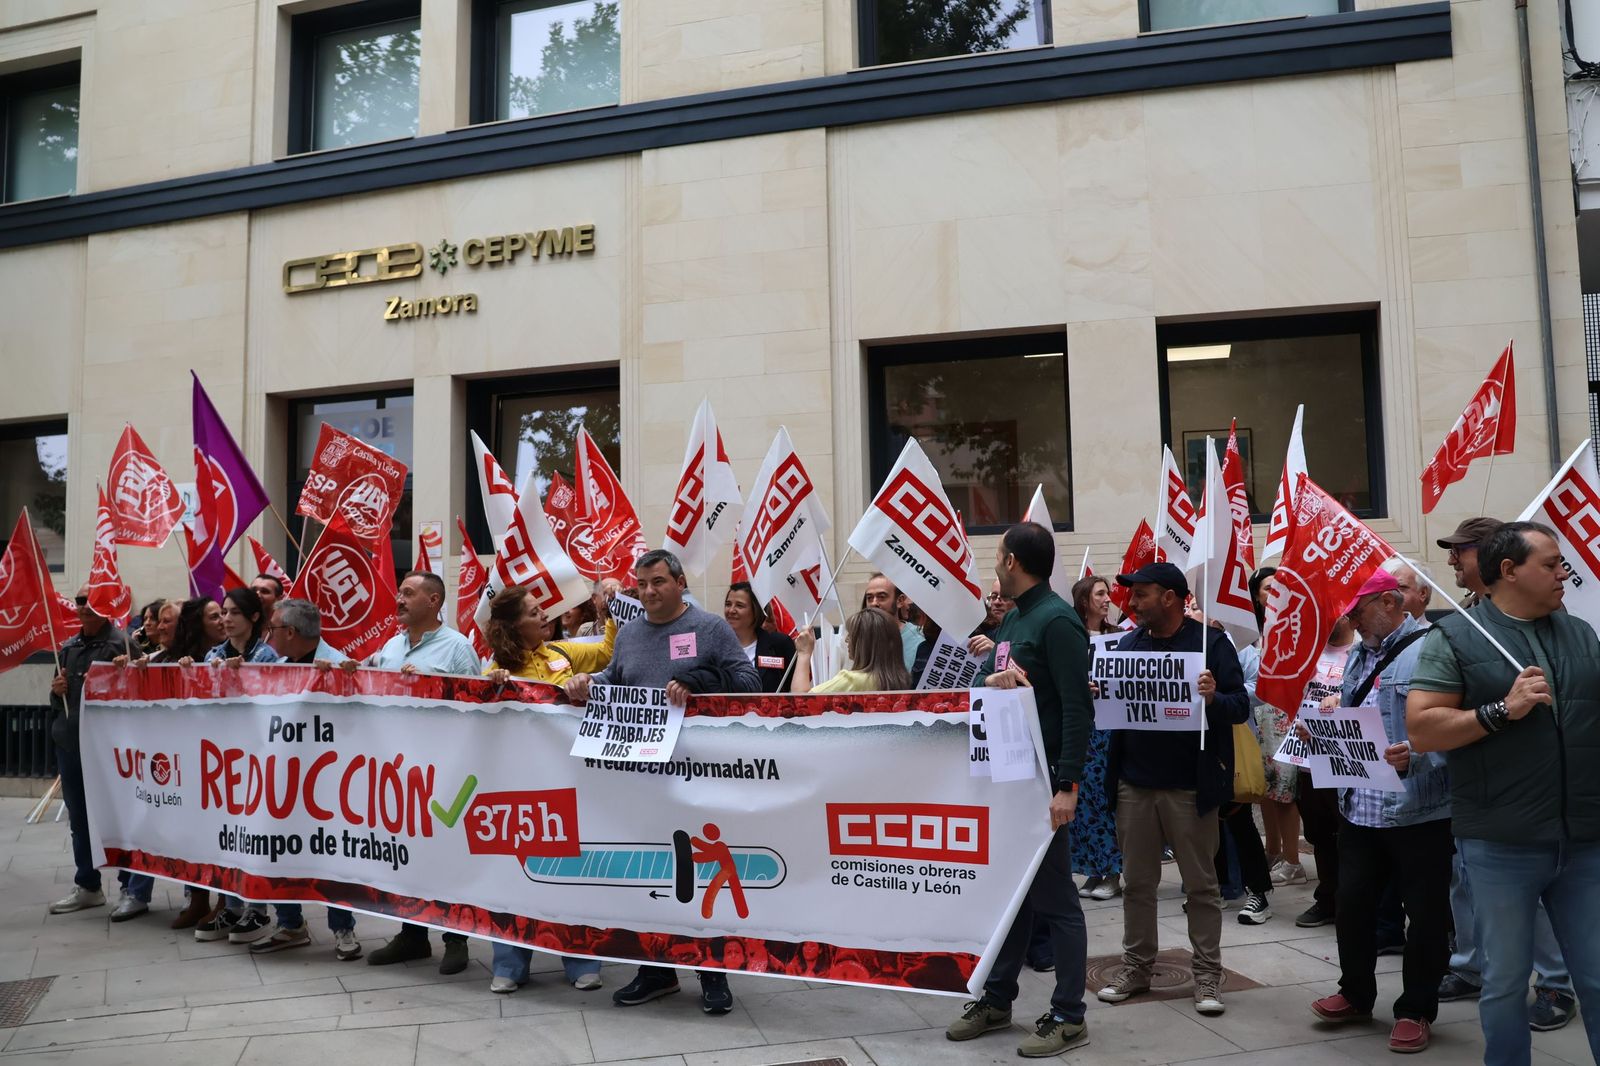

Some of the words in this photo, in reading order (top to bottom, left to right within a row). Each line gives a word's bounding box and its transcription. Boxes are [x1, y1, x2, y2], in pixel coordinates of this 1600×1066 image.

[462, 224, 595, 266] CEPYME
[383, 292, 478, 321] Zamora
[747, 463, 807, 565] CCOO
[765, 517, 805, 568] Zamora
[885, 533, 941, 589] Zamora
[323, 550, 370, 613] UGT
[939, 643, 955, 656] HA
[954, 646, 968, 660] SU
[933, 655, 948, 670] NO
[948, 660, 963, 673] EN
[1095, 653, 1185, 679] REDUCCIÓN
[926, 669, 943, 687] QUE
[652, 689, 667, 706] DE
[1115, 681, 1192, 702] JORNADA
[585, 701, 614, 721] PAPÁ
[617, 706, 669, 725] QUIEREN
[1126, 703, 1158, 723] ¡YA!
[268, 715, 306, 743] Por
[313, 714, 334, 743] la
[579, 720, 604, 738] QUE
[606, 724, 666, 743] TRABAJES
[1305, 719, 1363, 740] TRABAJAR
[1344, 741, 1379, 762] VIVIR
[1330, 757, 1370, 779] MEJOR
[154, 795, 160, 807] y
[162, 791, 182, 807] León
[200, 738, 435, 838] REDUCCIÓN
[838, 814, 979, 853] CCOO
[219, 824, 238, 852] del
[239, 827, 303, 863] tiempo
[310, 827, 337, 856] de
[342, 829, 410, 871] trabajo
[831, 859, 915, 876] comisiones
[919, 863, 977, 881] obreras
[831, 873, 850, 886] de
[853, 873, 908, 891] Castilla
[912, 881, 921, 894] y
[924, 879, 962, 895] León
